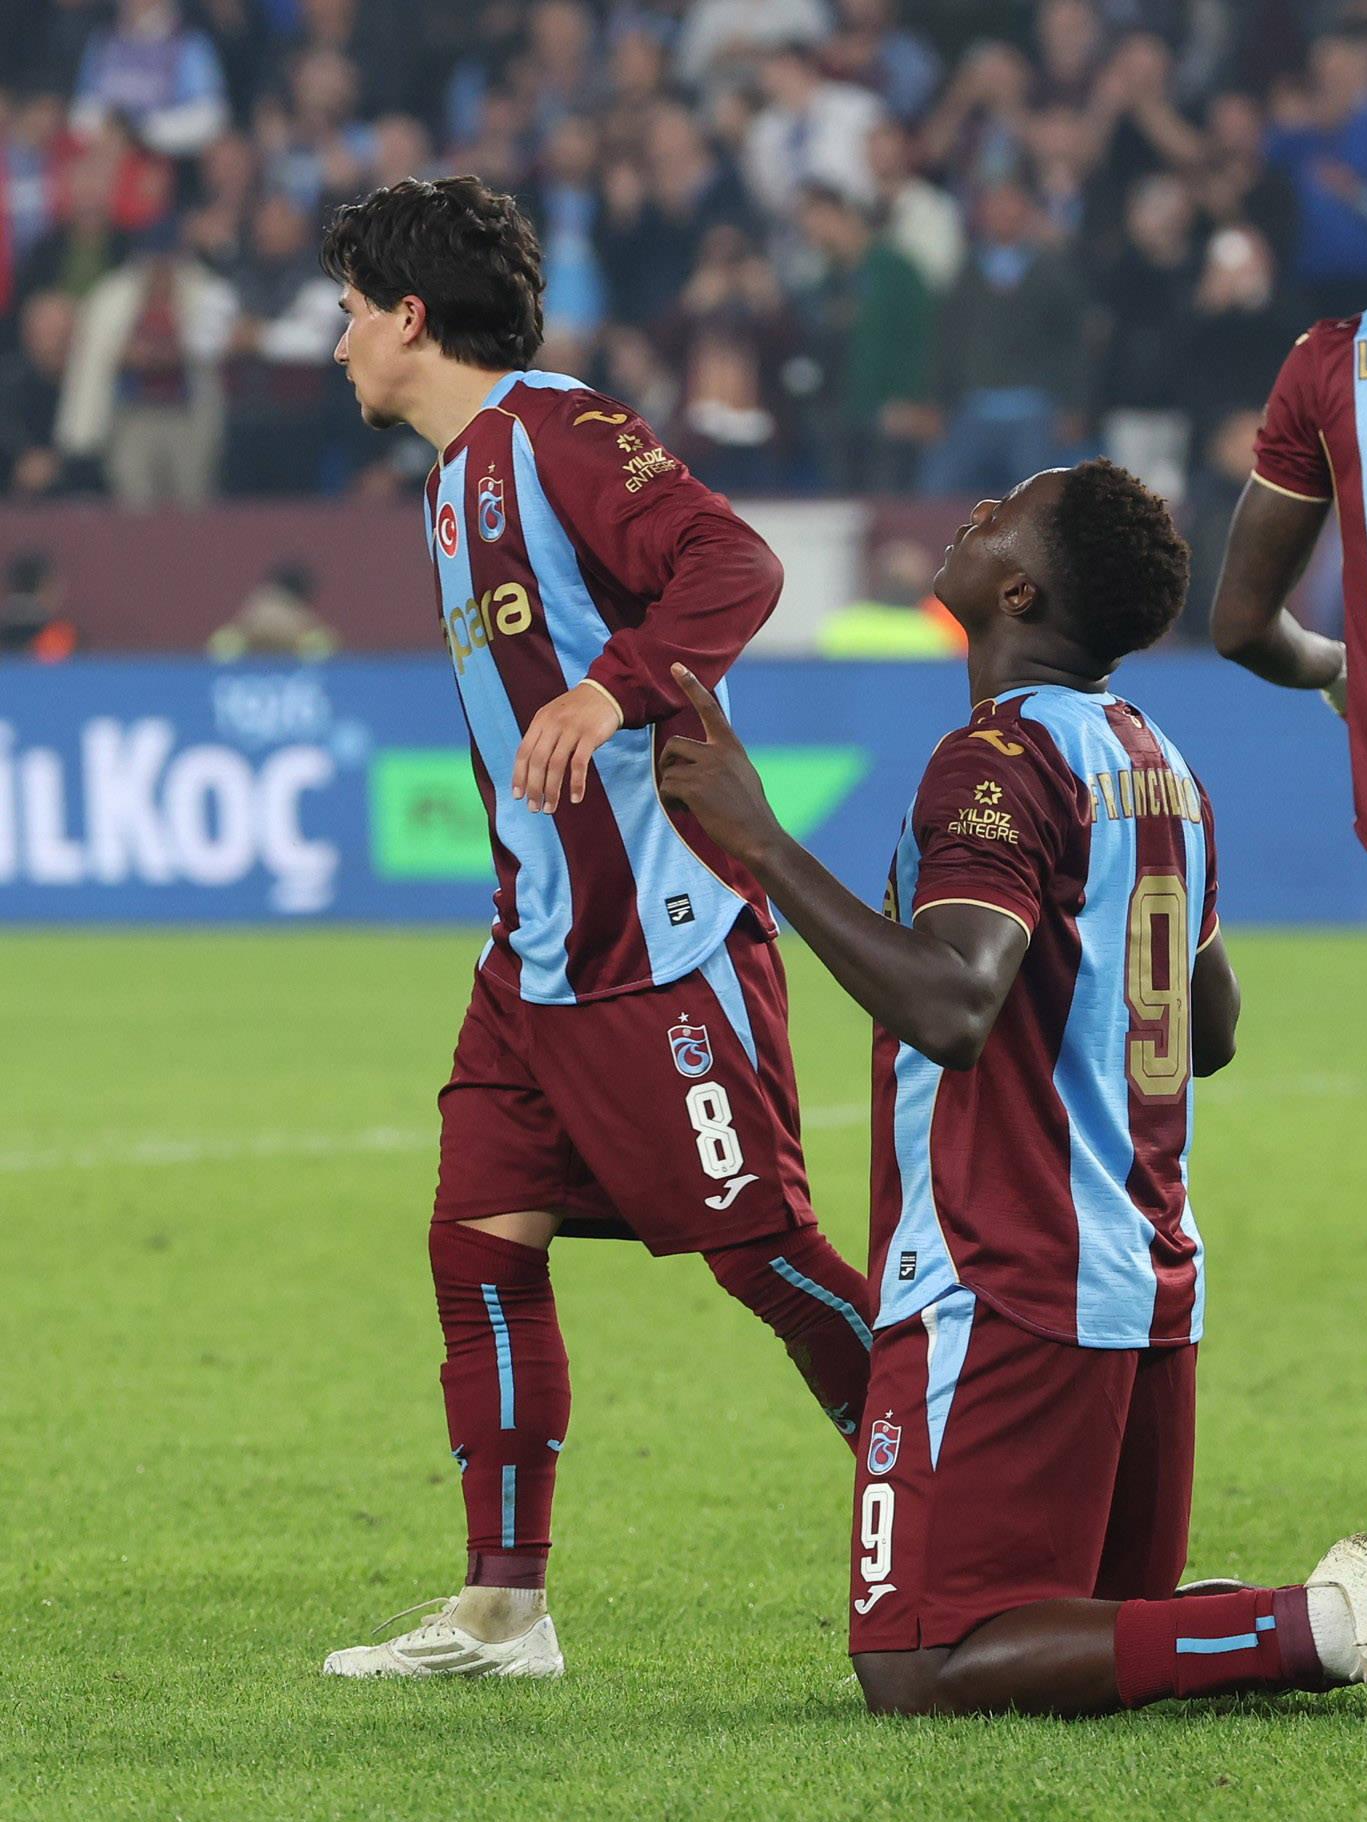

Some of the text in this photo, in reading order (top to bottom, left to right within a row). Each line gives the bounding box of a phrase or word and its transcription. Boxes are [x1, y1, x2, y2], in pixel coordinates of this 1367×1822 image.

[622, 448, 666, 473] YILDIZ
[440, 582, 533, 675] para
[947, 821, 1020, 845] ENTEGRE
[958, 809, 1012, 828] YILDIZ
[1127, 870, 1190, 1101] 9
[686, 1080, 744, 1180] 8
[860, 1483, 895, 1583] 9
